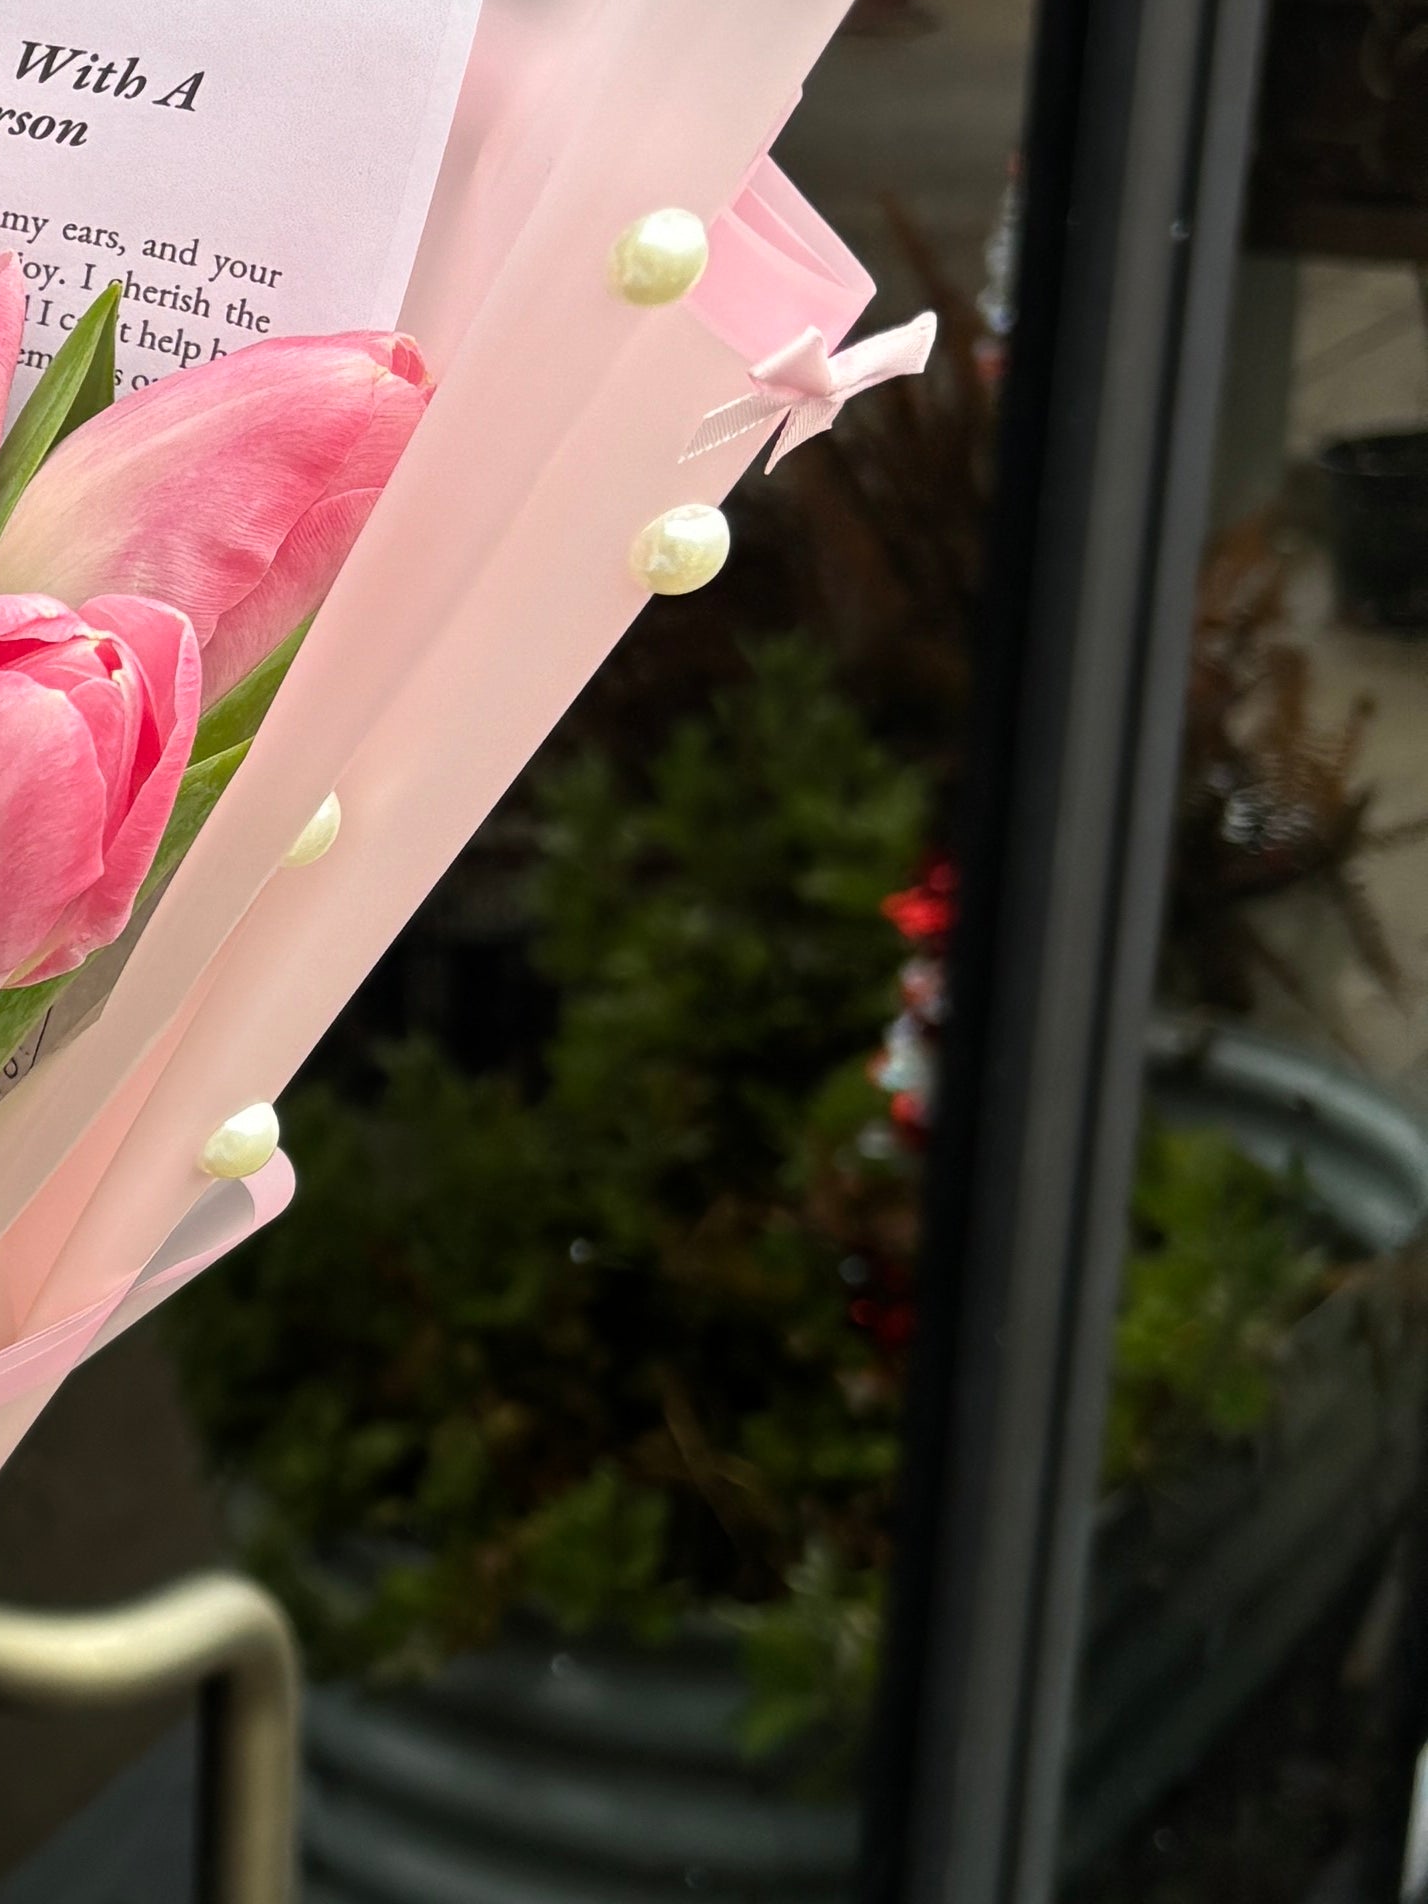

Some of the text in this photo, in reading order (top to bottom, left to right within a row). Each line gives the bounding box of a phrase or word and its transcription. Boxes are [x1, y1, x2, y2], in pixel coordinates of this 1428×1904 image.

[12, 39, 150, 100] With
[152, 69, 207, 113] A
[61, 221, 128, 256] ears,
[140, 238, 200, 269] and
[207, 251, 284, 290] your
[35, 298, 55, 328] I
[136, 319, 203, 370] help
[79, 262, 98, 291] I
[224, 296, 272, 335] the
